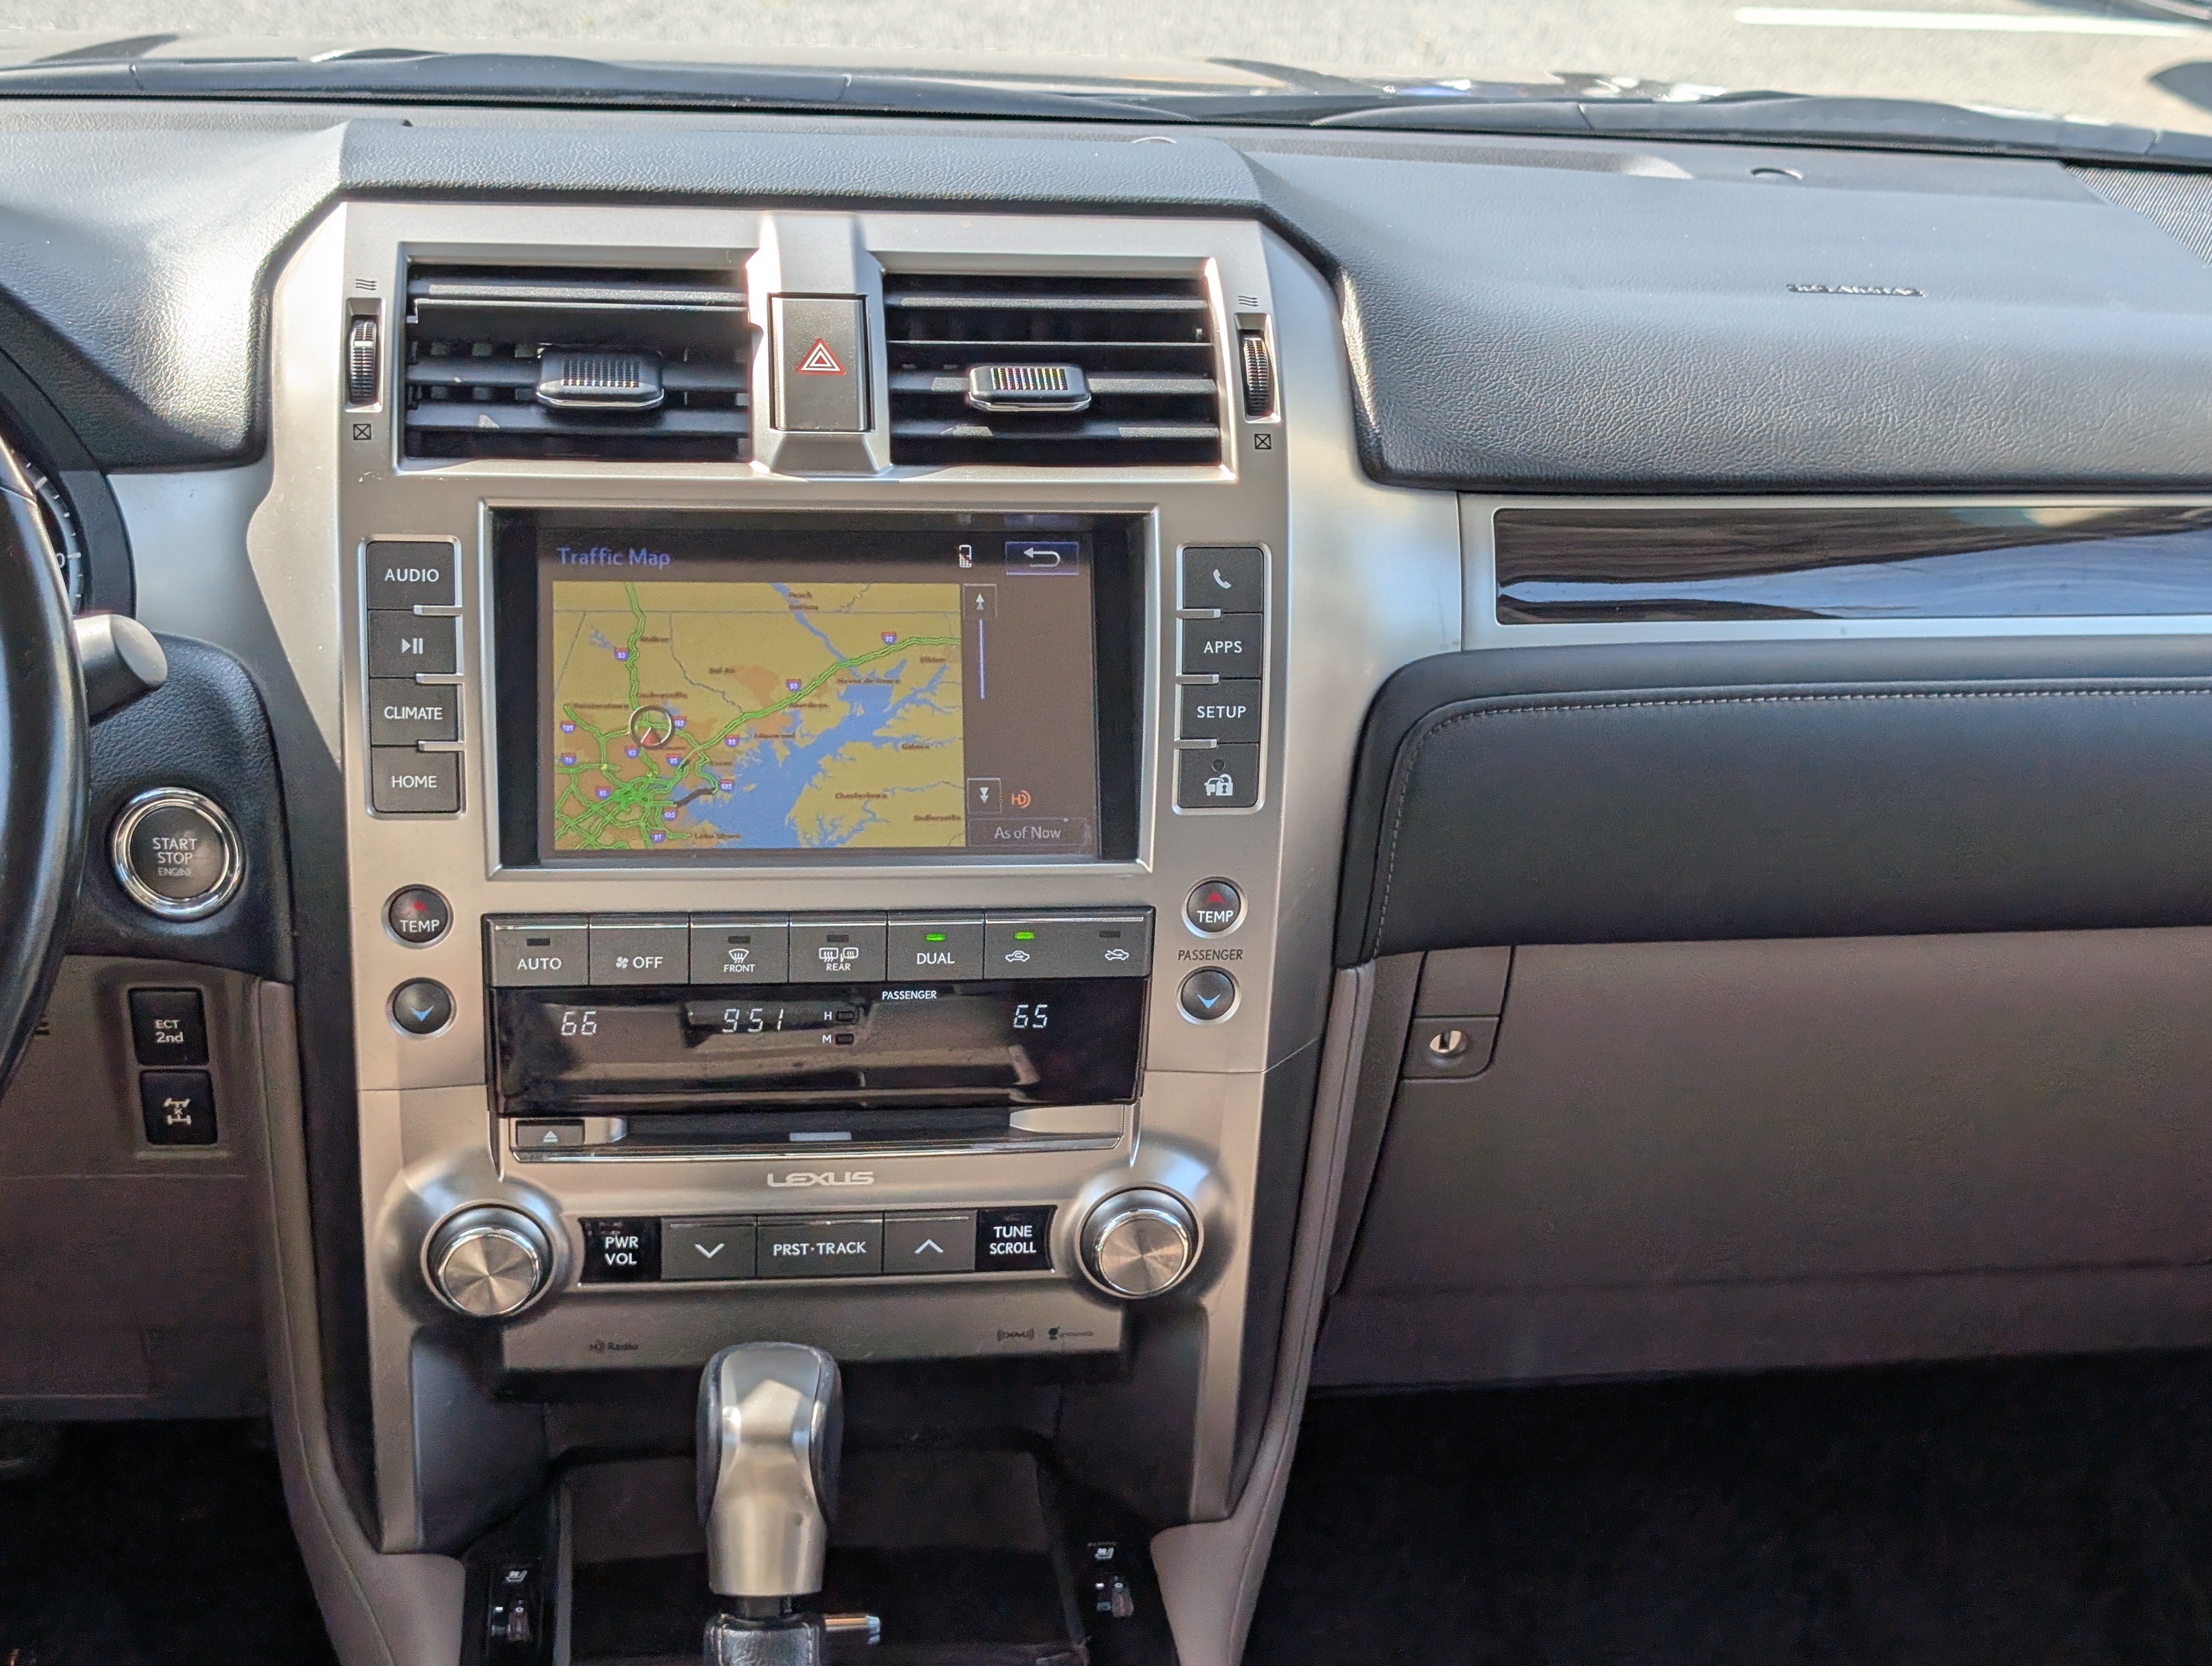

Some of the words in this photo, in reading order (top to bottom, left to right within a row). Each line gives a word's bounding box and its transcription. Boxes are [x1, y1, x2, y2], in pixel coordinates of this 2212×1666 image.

[557, 547, 623, 566] Traffic
[628, 547, 671, 569] Map
[384, 568, 439, 582] AUDIO
[1203, 640, 1242, 653] APPS
[384, 706, 442, 720] CLIMATE
[1197, 706, 1246, 719] SETUP
[391, 775, 438, 788] HOME
[994, 826, 1010, 839] As
[1013, 826, 1027, 839] of
[1031, 826, 1061, 838] Now
[152, 837, 197, 850] START
[157, 852, 194, 864] STOP
[1197, 910, 1233, 923] TEMP
[400, 919, 440, 932] TEMP
[916, 952, 955, 965] DUAL
[1178, 949, 1243, 960] PASSENGER
[517, 957, 562, 970] AUTO
[633, 956, 663, 969] OFF
[724, 964, 755, 972] FRONT
[826, 963, 851, 971] REAR
[882, 990, 937, 1000] PASSENGER
[824, 1011, 832, 1020] H
[1013, 1004, 1048, 1028] 65
[155, 1019, 179, 1029] ECT
[561, 1011, 597, 1036] 66
[155, 1031, 184, 1043] 2nd
[822, 1034, 832, 1043] M
[767, 1171, 874, 1187] LEXUS
[993, 1225, 1032, 1238] TUNE
[605, 1236, 638, 1248] PWR
[990, 1241, 1037, 1254] SCROLL
[605, 1253, 637, 1265] VOL
